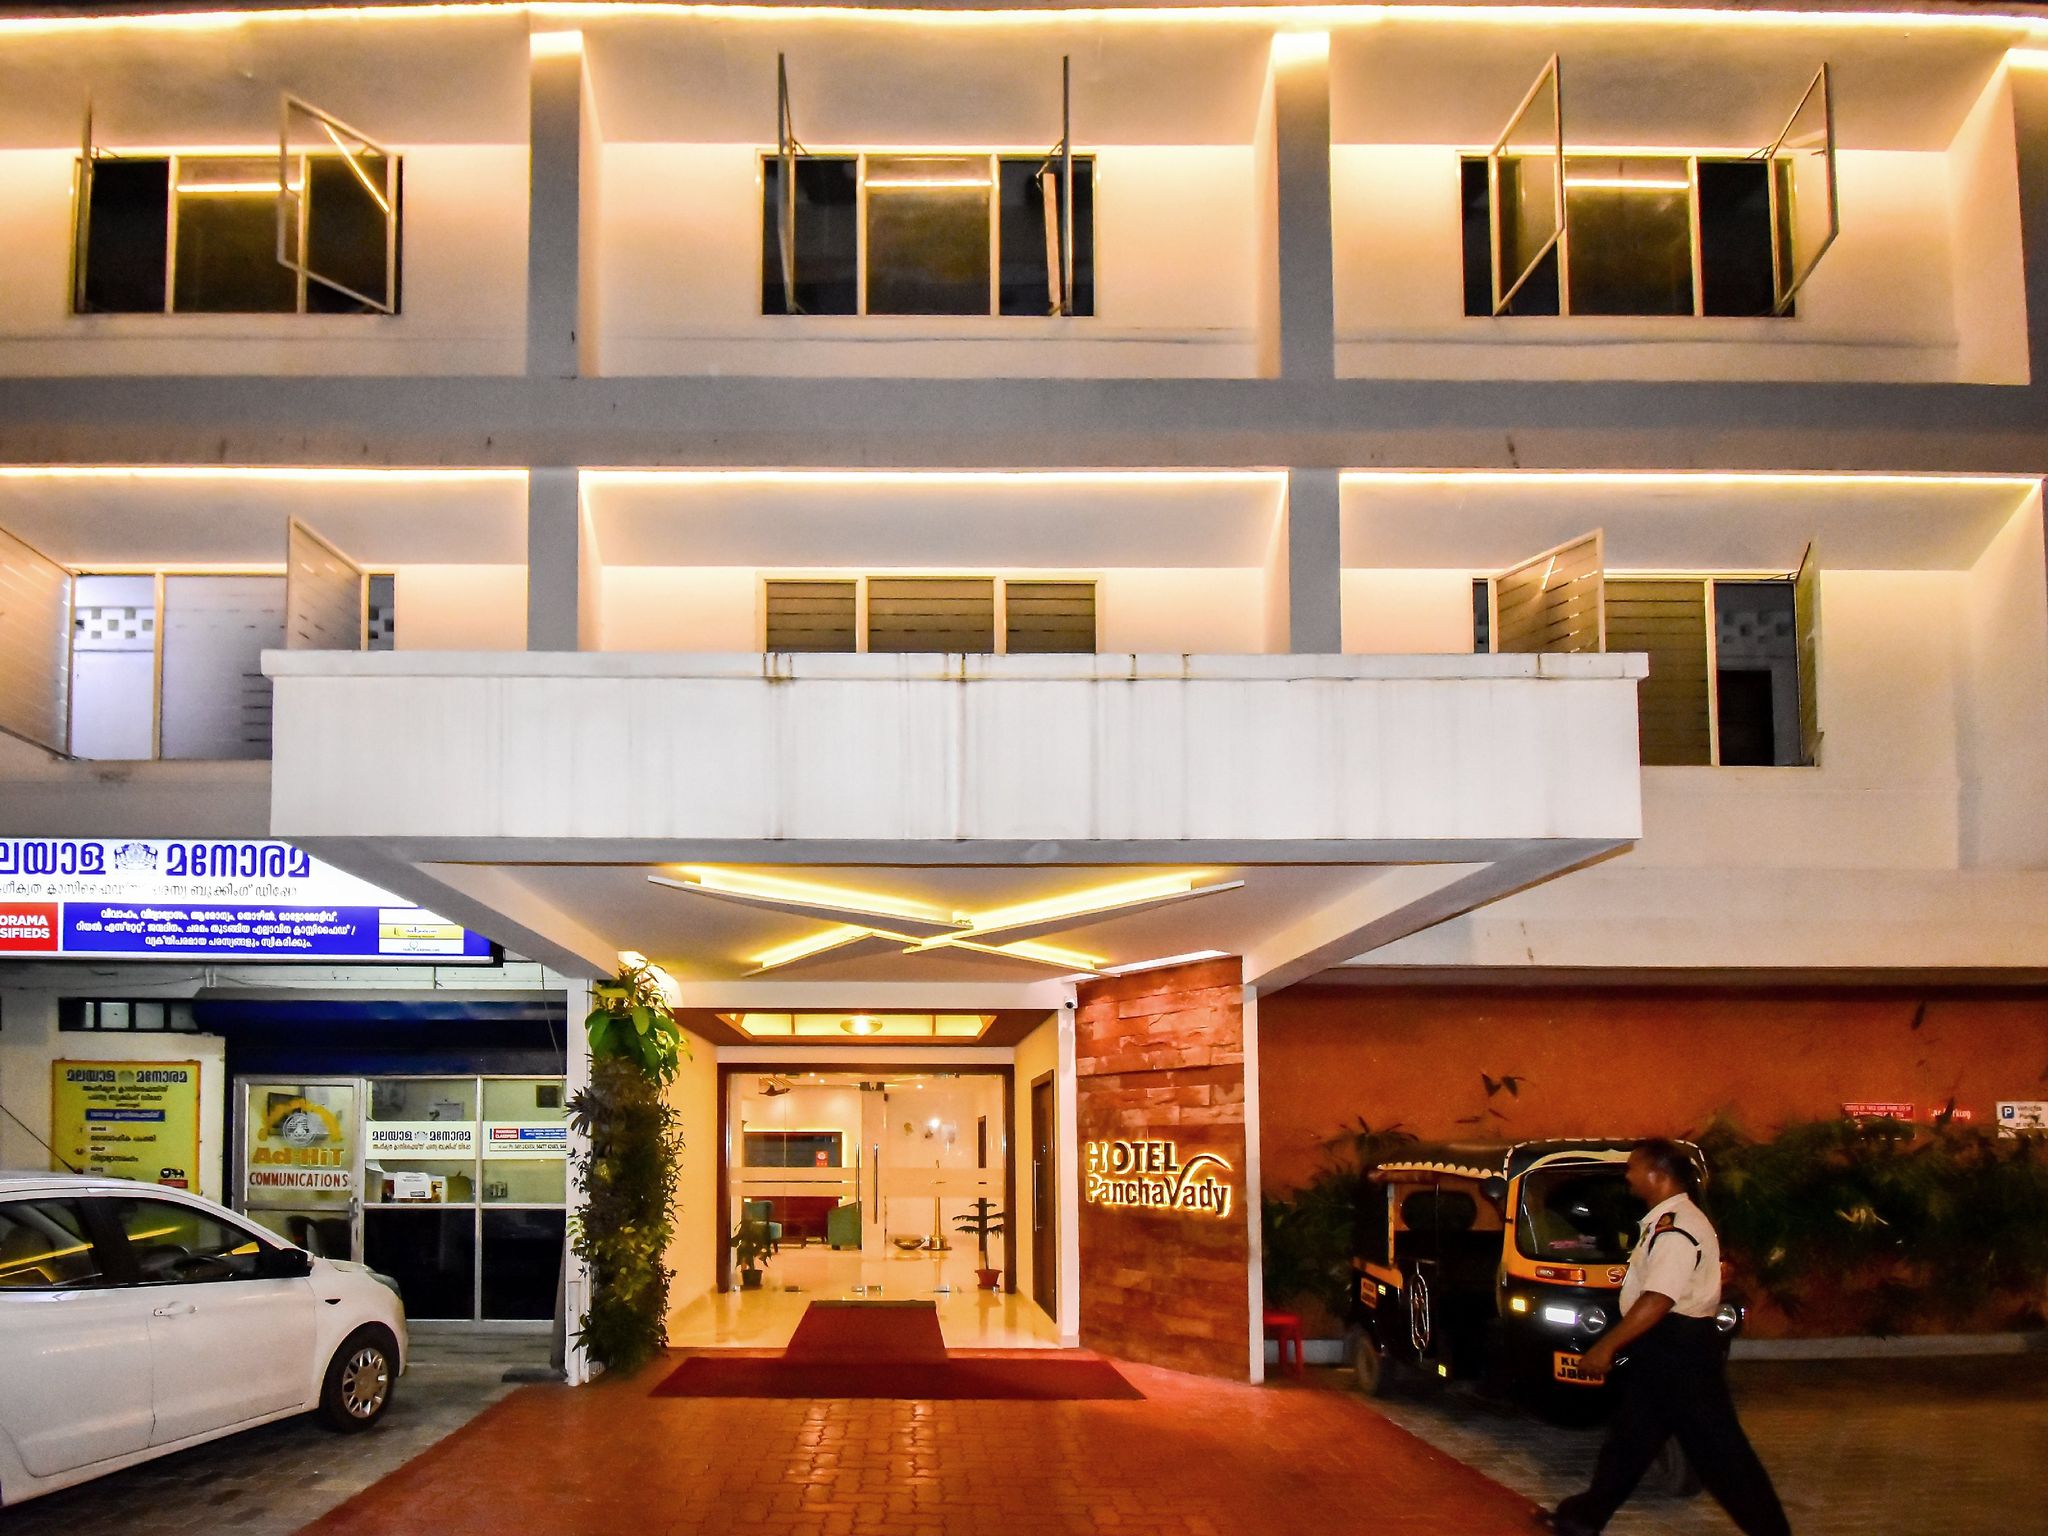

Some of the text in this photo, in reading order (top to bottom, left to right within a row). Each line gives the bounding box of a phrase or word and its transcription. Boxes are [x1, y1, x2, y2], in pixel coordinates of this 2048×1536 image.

[166, 844, 310, 877] മനോരമ
[136, 1070, 188, 1083] മനോരമ
[372, 1130, 471, 1141] മലയാള മനോരമ
[1087, 1142, 1181, 1175] HOTEL
[249, 1172, 349, 1187] COMMUNICATIONS
